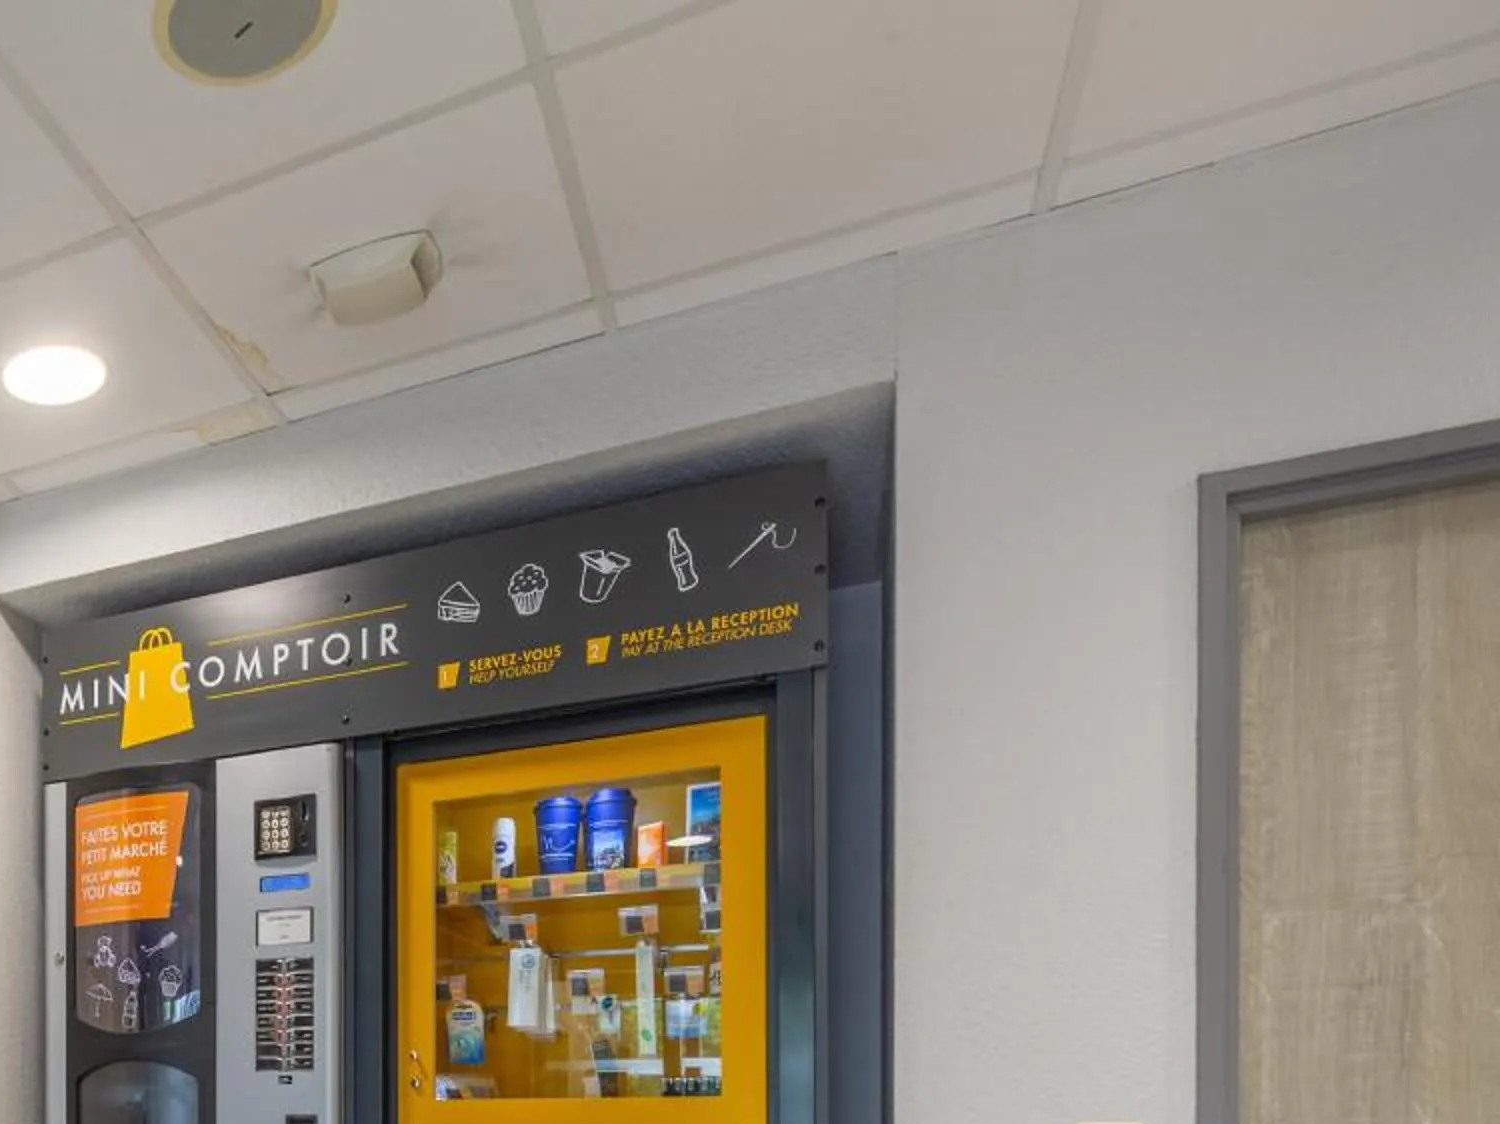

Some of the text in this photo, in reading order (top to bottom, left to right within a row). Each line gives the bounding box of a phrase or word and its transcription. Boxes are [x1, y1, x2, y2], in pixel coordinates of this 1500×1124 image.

[620, 602, 800, 645] PAYEZ A LA RECEPTION
[645, 641, 661, 655] AT
[663, 636, 685, 652] THE
[687, 624, 756, 649] RECEPTION
[757, 617, 793, 636] DESK
[59, 623, 400, 715] MINI COMPTOIR
[468, 644, 563, 672] SERVEZ-VOUS
[468, 660, 556, 685] HELP YOURSELF
[121, 819, 168, 839] VOTRE
[109, 837, 169, 860] MARCHÉ
[81, 880, 142, 900] YOU NEED
